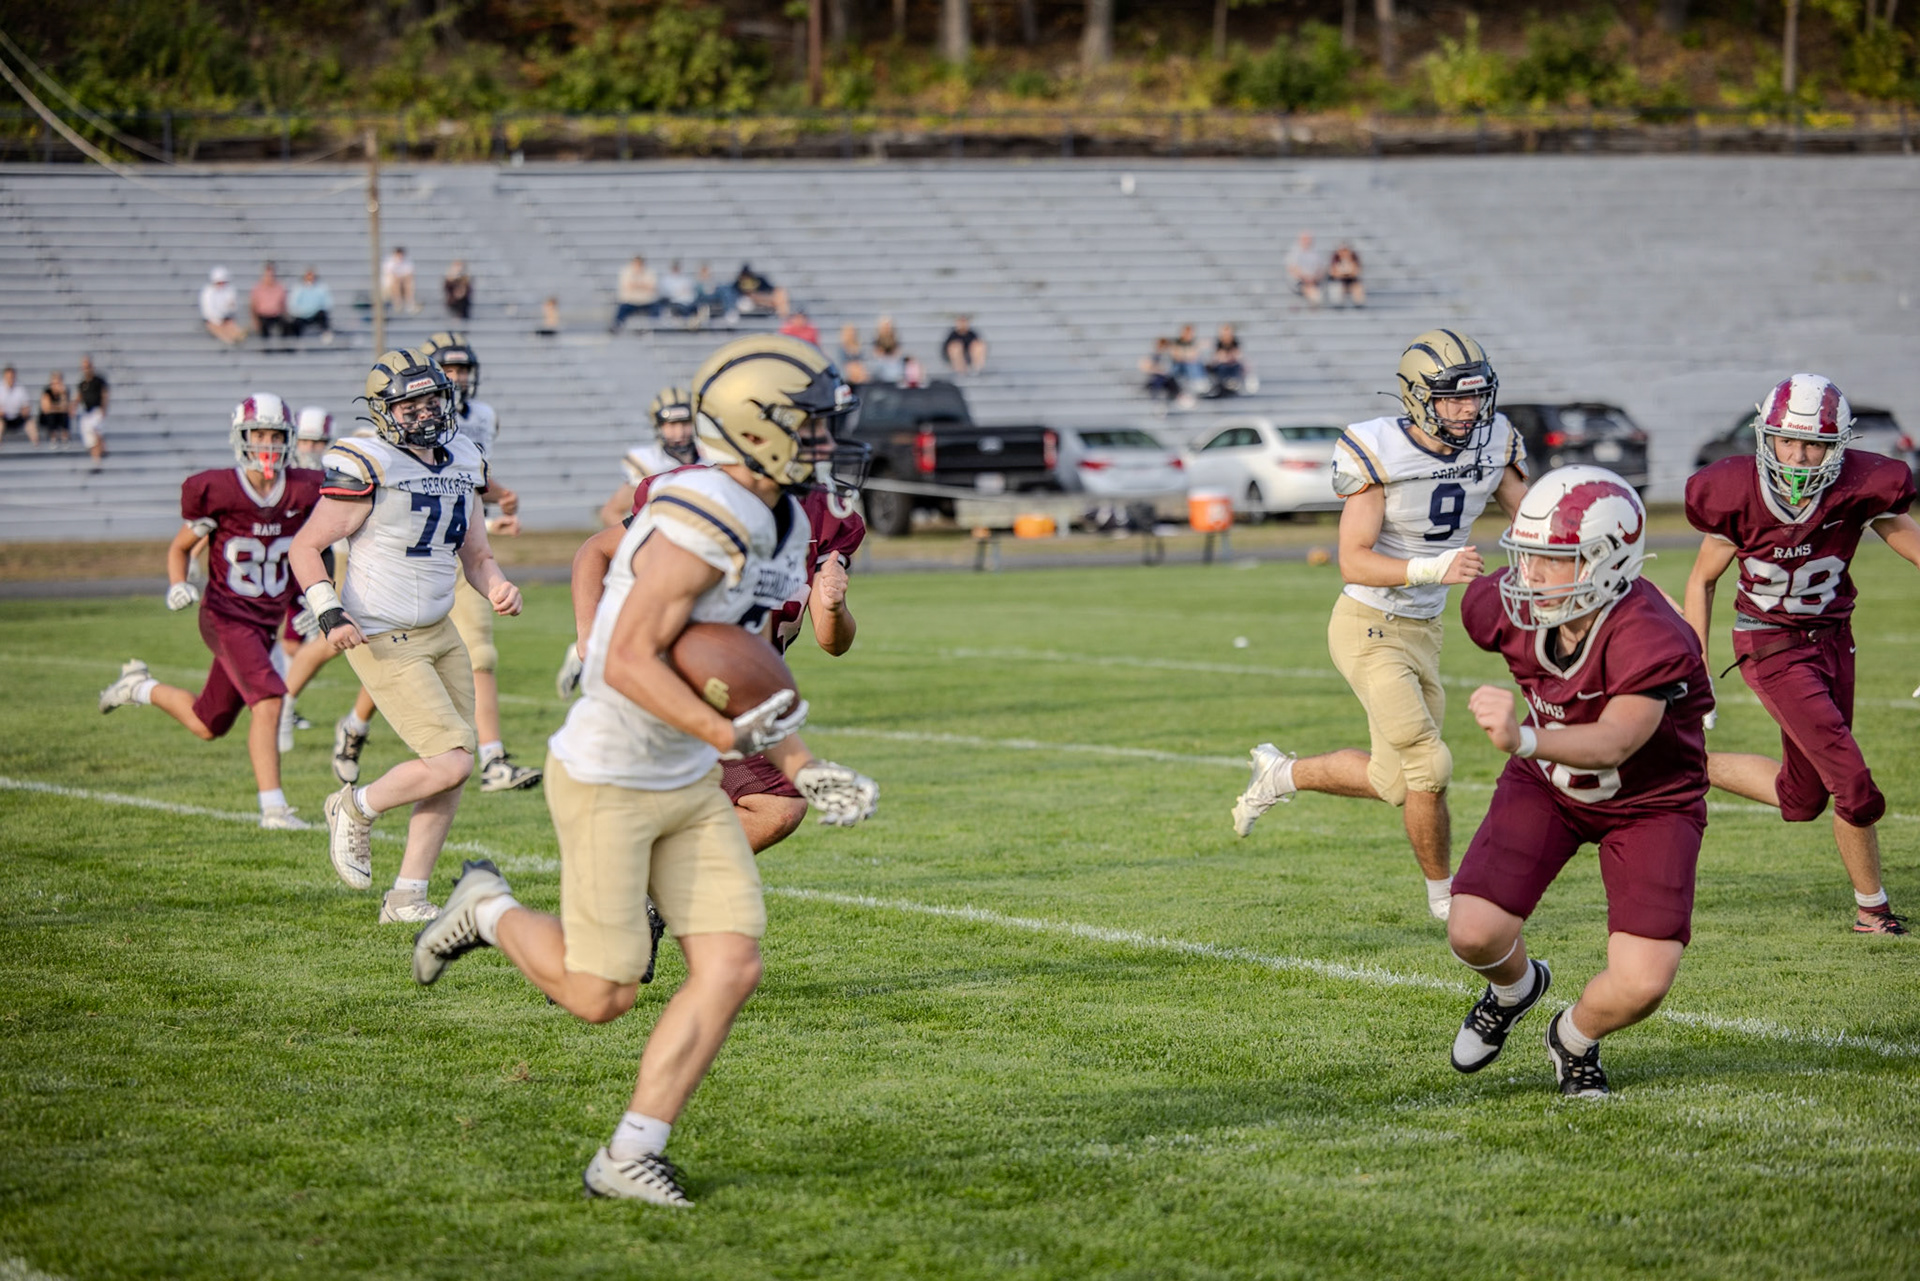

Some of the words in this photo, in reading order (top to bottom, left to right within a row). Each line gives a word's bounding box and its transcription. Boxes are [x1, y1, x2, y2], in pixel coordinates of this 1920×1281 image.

[409, 378, 432, 389] Riddell
[1462, 379, 1483, 387] Riddell
[1787, 422, 1813, 431] Riddell
[1423, 482, 1466, 542] 9
[252, 522, 282, 537] RAMS
[406, 492, 468, 557] 74
[1515, 528, 1539, 540] Riddell
[1773, 543, 1812, 559] RAMS
